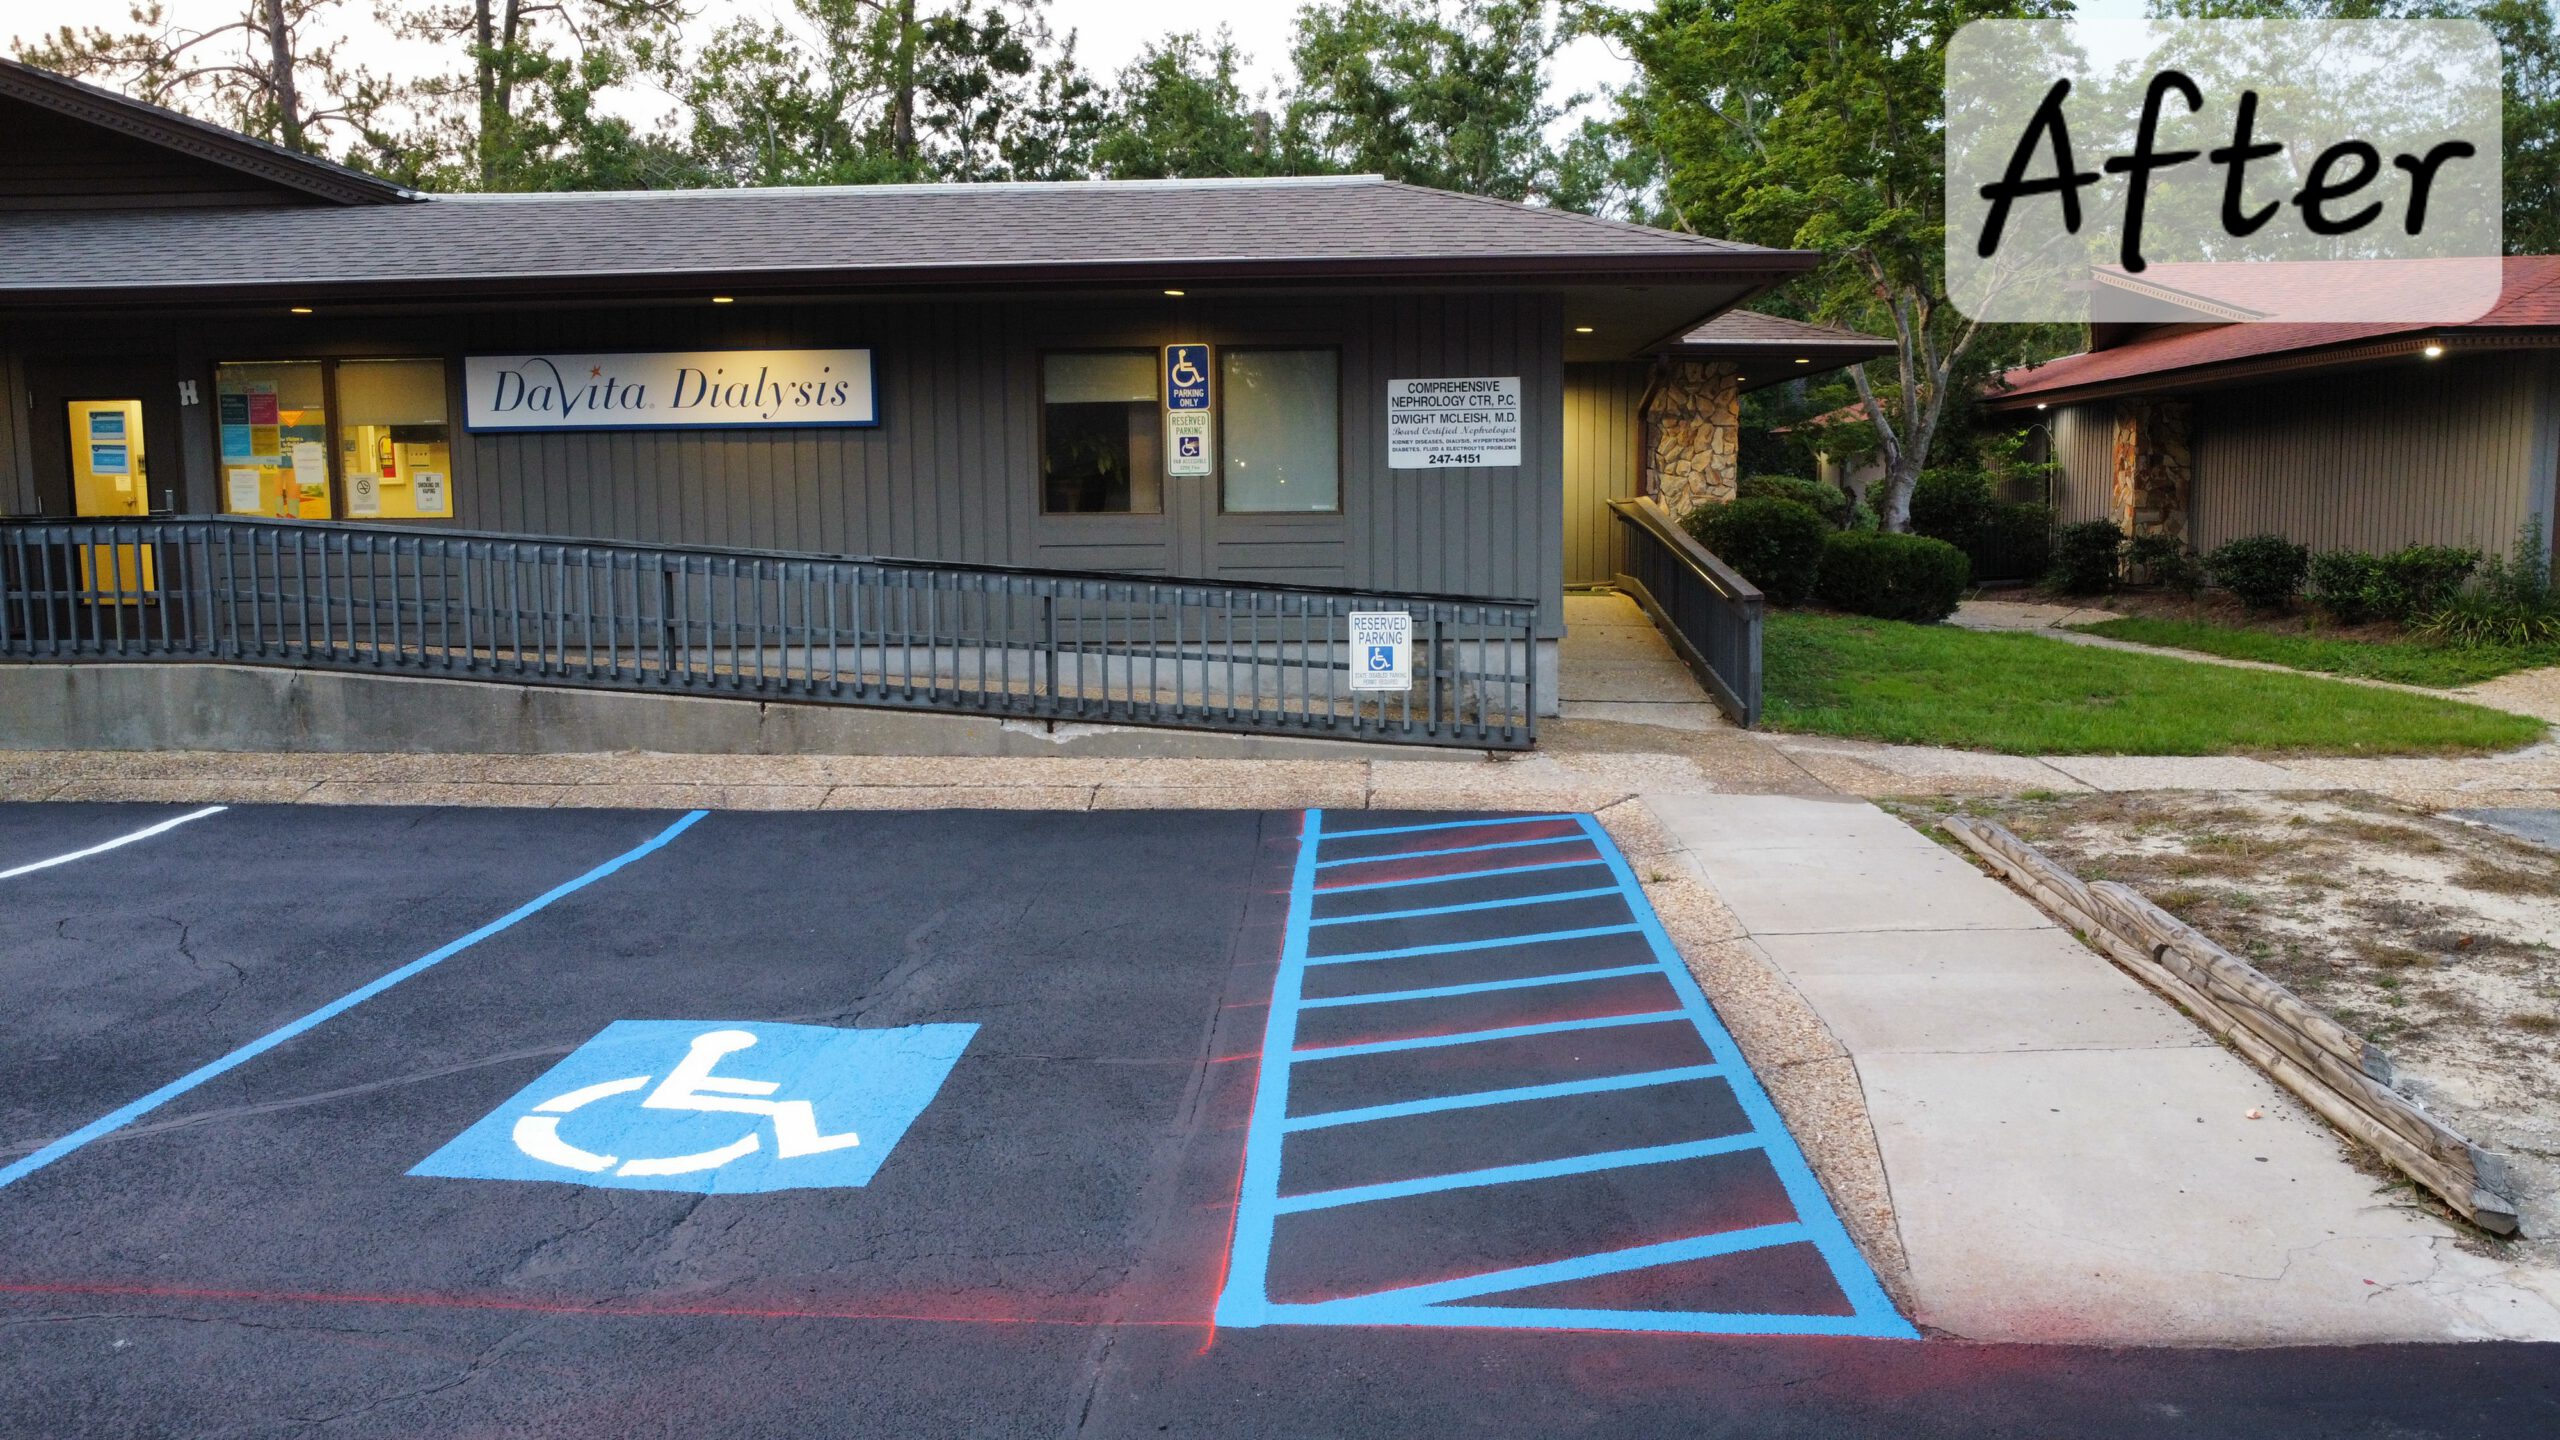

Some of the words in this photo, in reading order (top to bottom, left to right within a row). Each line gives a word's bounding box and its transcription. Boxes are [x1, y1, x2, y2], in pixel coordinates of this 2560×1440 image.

[178, 379, 199, 406] H
[491, 357, 648, 419] DaVita
[670, 365, 850, 420] Dialysis
[1173, 389, 1205, 398] PARKING
[1407, 380, 1500, 394] COMPREHENSIVE
[1179, 398, 1199, 407] ONLY
[1391, 395, 1465, 408] NEPHROLOGY
[1468, 395, 1494, 407] CTR,
[1497, 394, 1516, 406] P.C.
[1172, 415, 1206, 426] RESERVED
[1391, 413, 1436, 425] DWIGHT
[1439, 413, 1491, 424] MCLEISH,
[1495, 412, 1517, 423] M.D.
[1175, 426, 1203, 436] PARKING
[1392, 426, 1419, 436] Board
[1422, 426, 1458, 437] Certified
[1460, 425, 1516, 438] Nephrologist
[1428, 454, 1481, 464] 247-4151
[1354, 617, 1407, 631] RESERVED
[1358, 632, 1403, 645] PARKING
